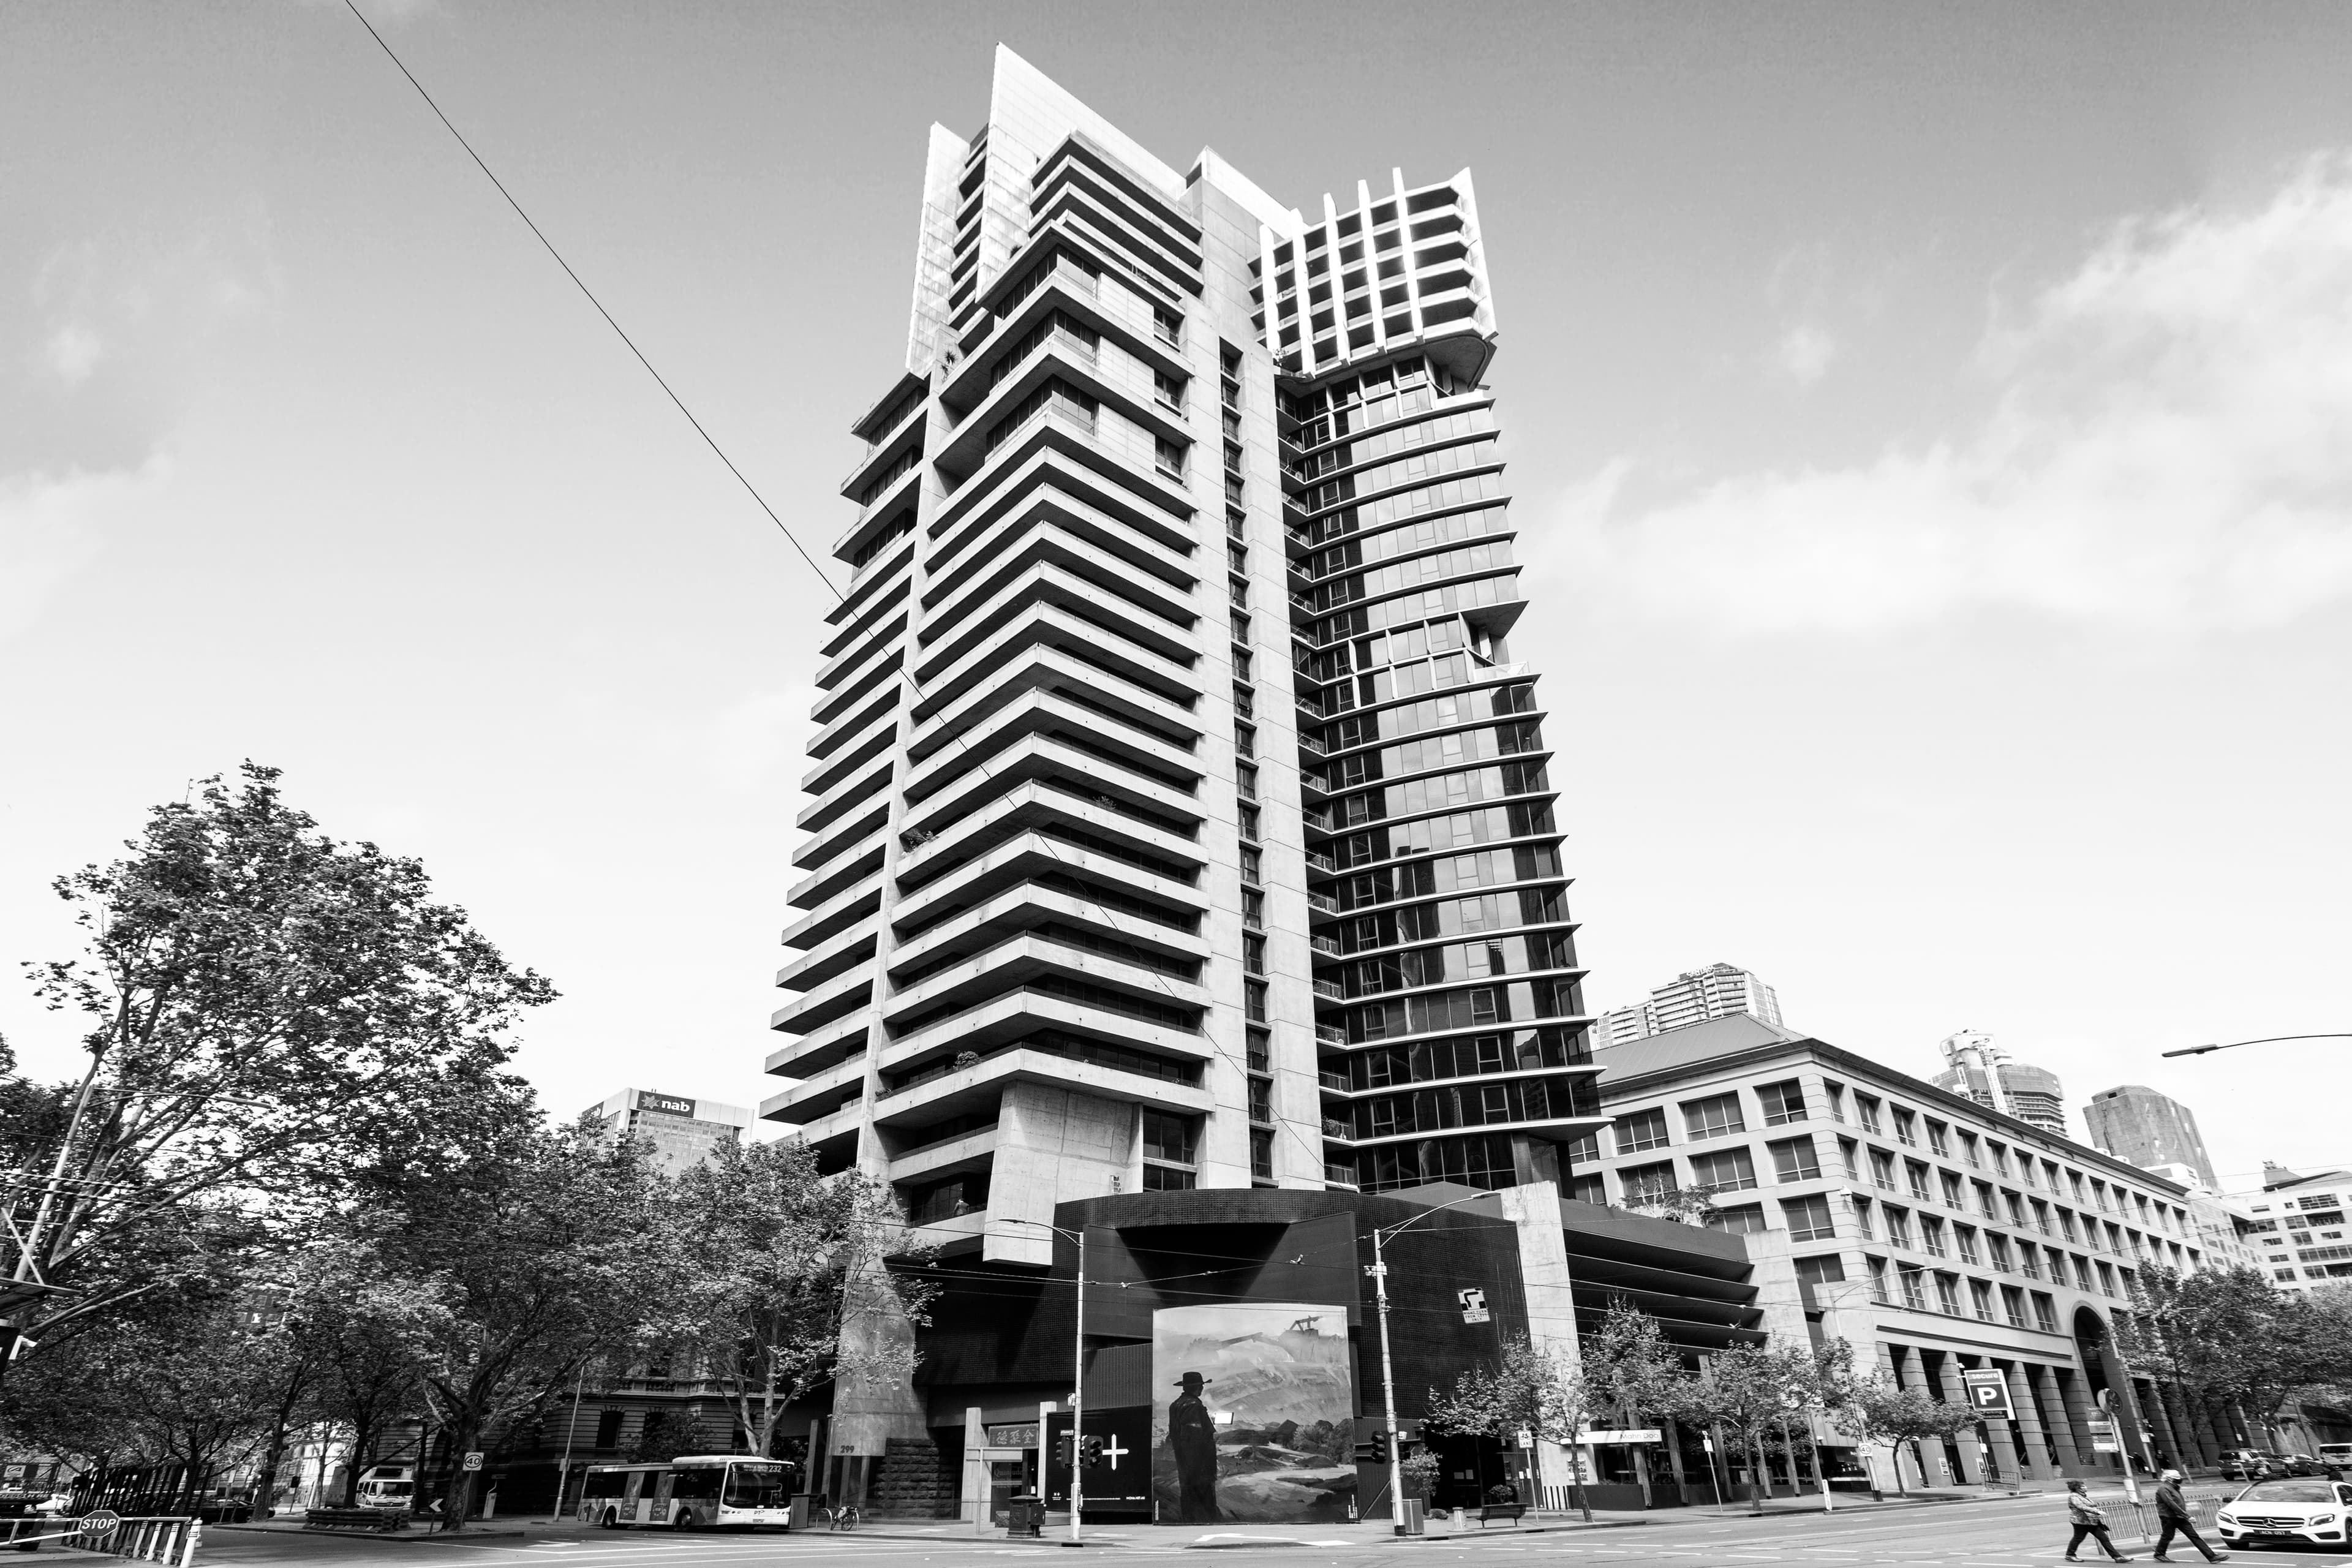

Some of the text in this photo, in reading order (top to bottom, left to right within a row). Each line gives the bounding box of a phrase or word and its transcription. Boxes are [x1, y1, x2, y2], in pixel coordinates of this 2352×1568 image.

[662, 1100, 690, 1112] nab
[1977, 1387, 1997, 1405] P
[840, 1445, 854, 1453] 299
[81, 1518, 116, 1529] STOP
